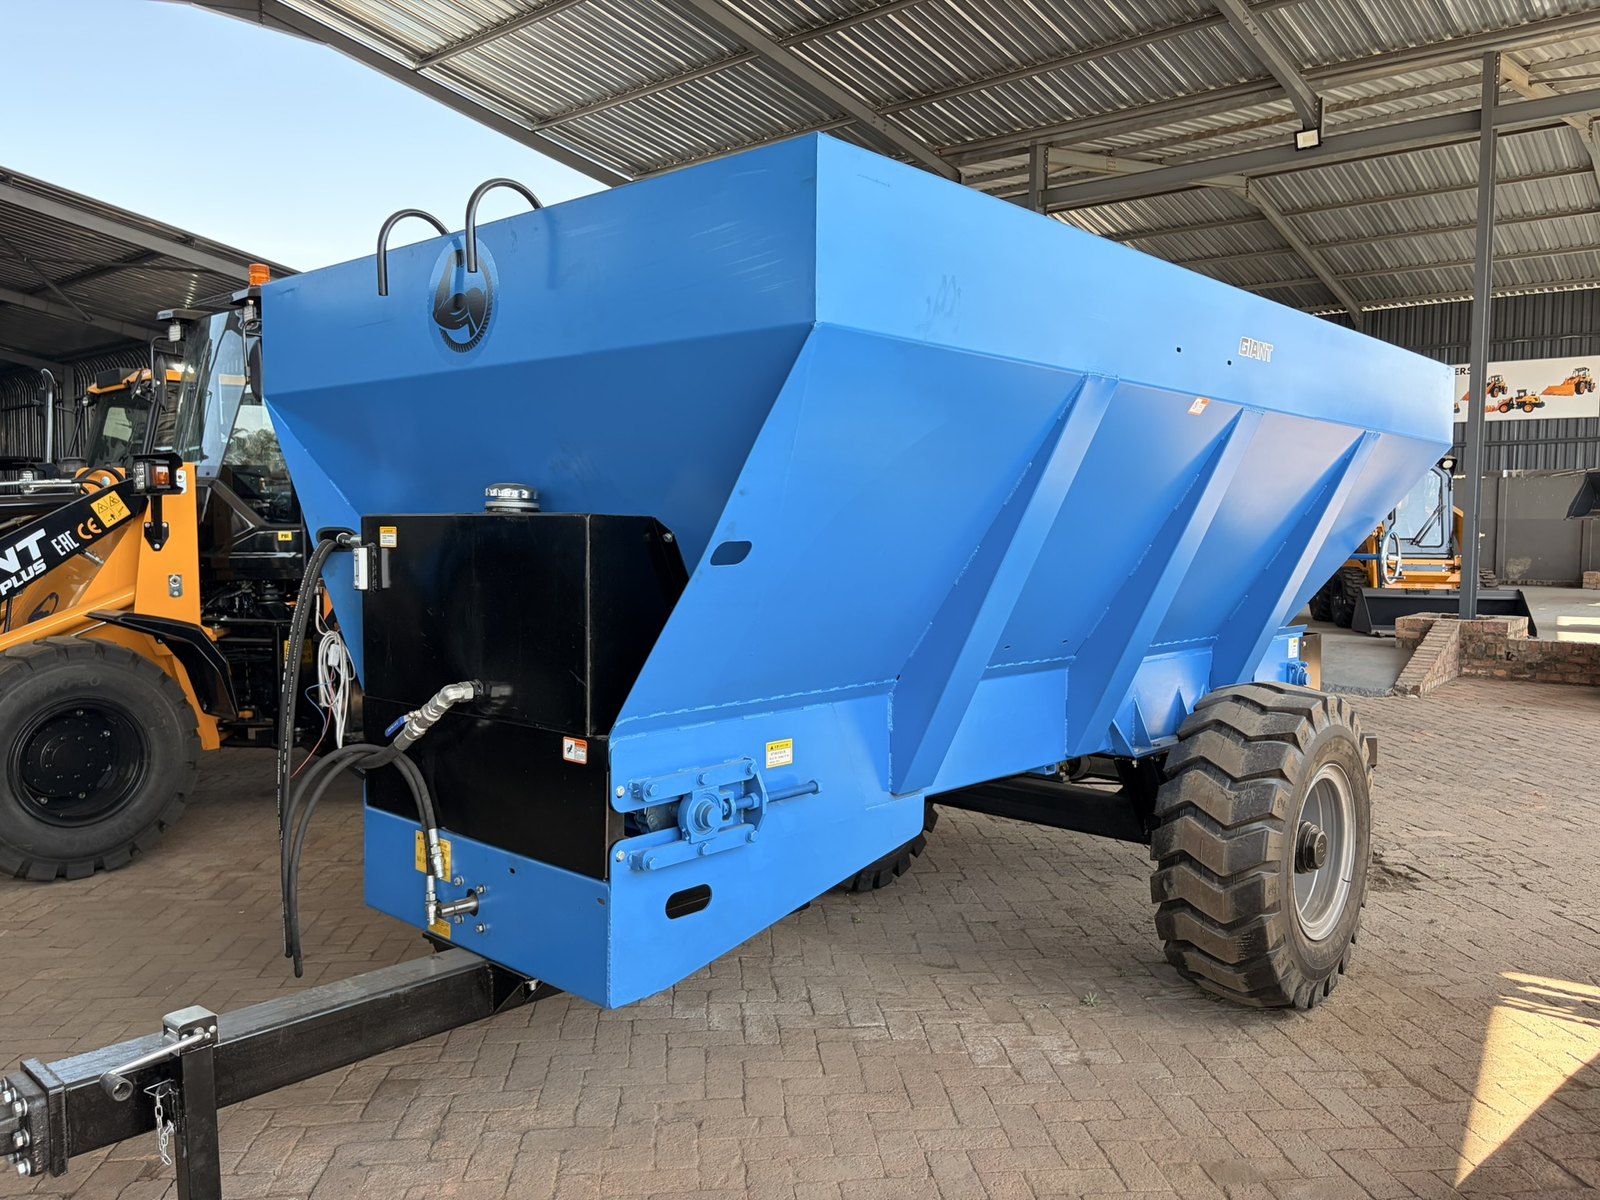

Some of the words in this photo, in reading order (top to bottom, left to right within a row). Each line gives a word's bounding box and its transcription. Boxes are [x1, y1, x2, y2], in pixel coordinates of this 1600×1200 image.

[1239, 336, 1274, 362] GIANT
[77, 517, 102, 540] CE
[50, 530, 80, 557] EAC
[0, 558, 47, 596] PLUS
